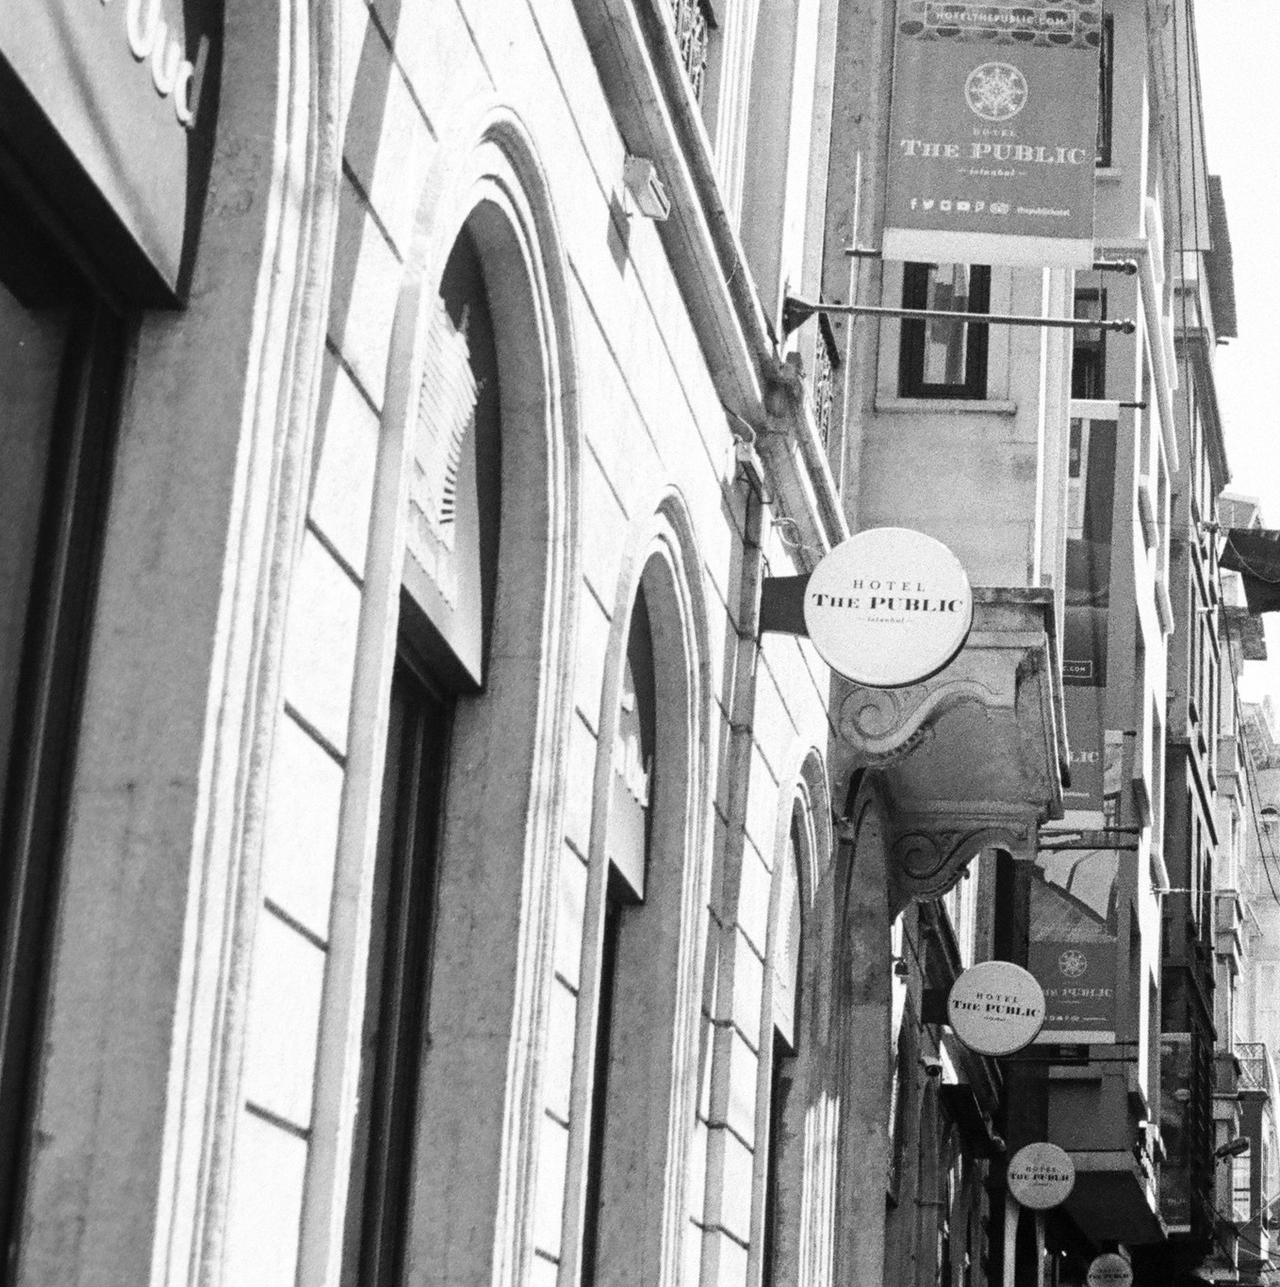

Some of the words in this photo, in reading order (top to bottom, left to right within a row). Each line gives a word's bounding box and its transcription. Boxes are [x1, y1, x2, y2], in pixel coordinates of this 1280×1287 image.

[900, 139, 960, 158] THE
[970, 142, 1087, 165] PUBLIC
[853, 579, 926, 593] HOTEL
[812, 593, 860, 609] THE
[870, 597, 963, 614] PUBLIC
